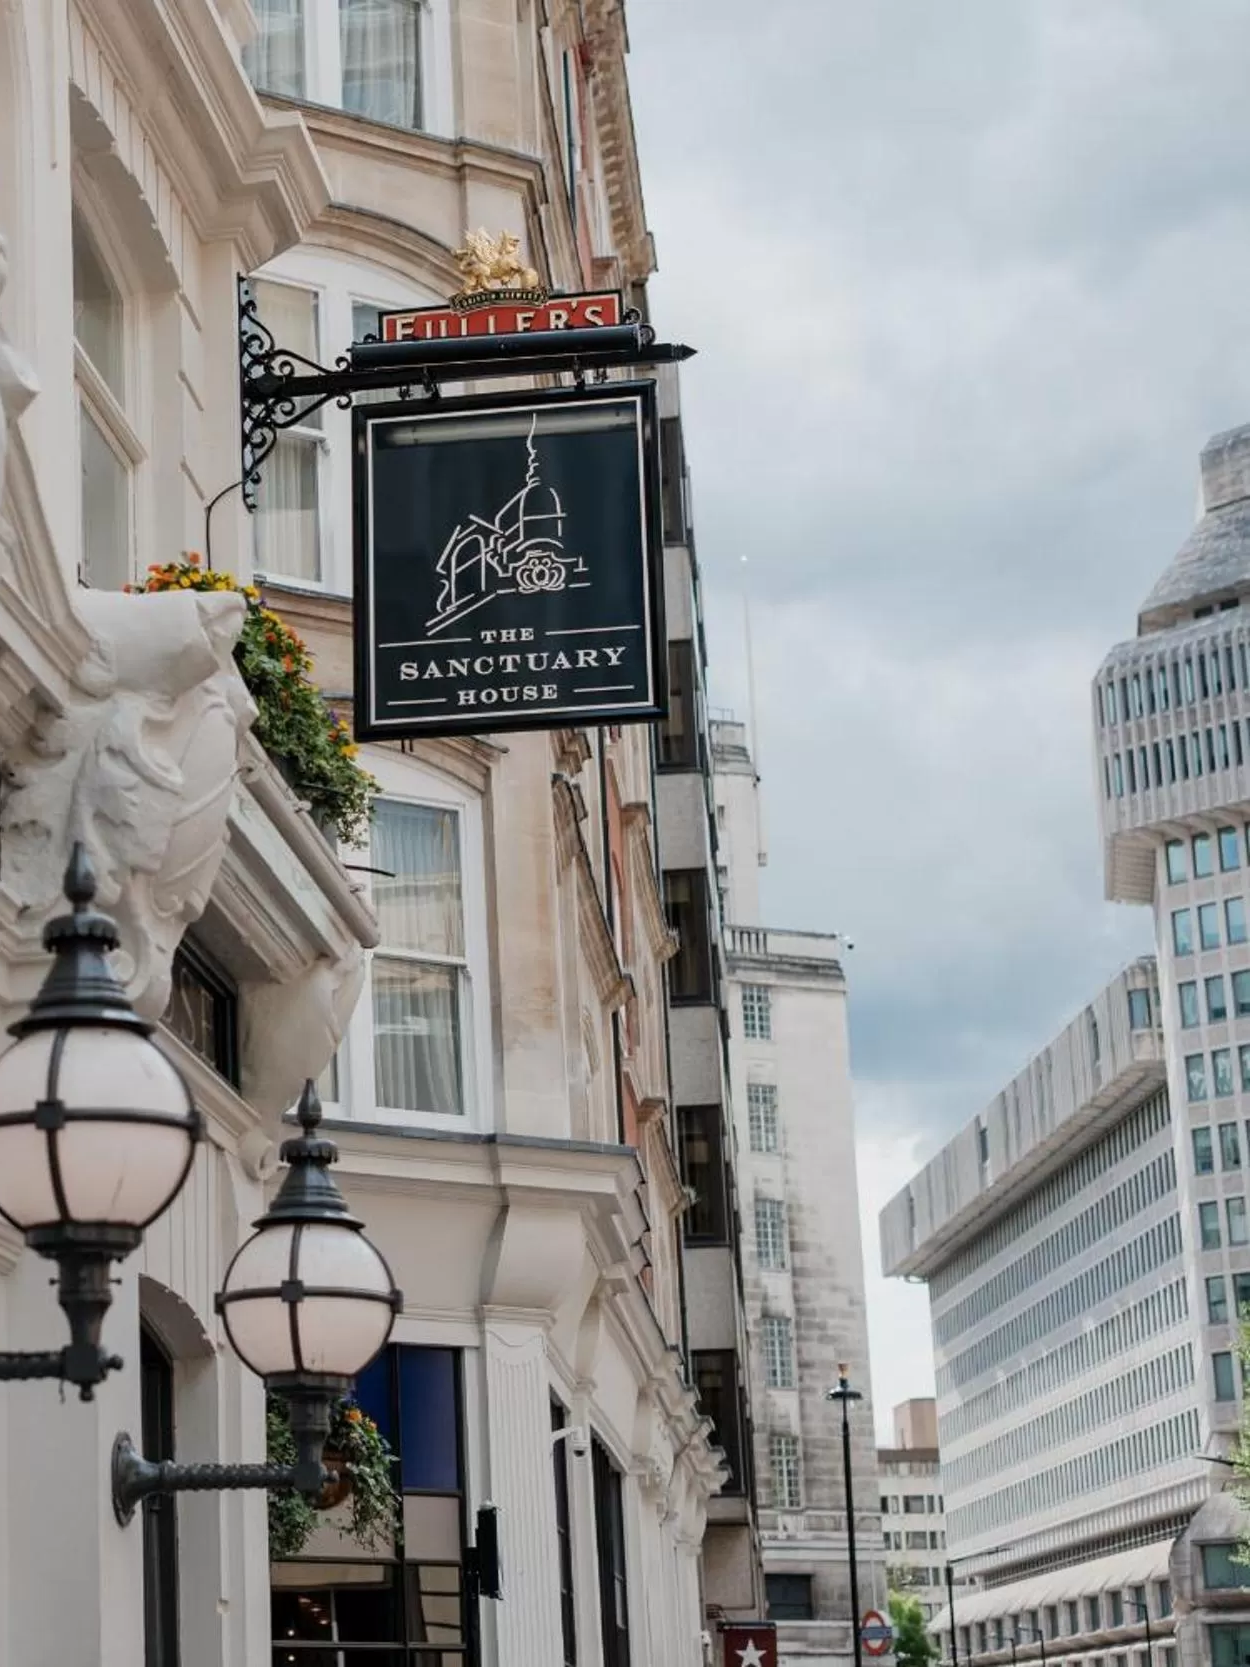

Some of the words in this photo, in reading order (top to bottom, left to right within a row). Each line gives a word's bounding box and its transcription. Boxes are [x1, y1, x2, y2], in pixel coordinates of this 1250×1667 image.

[481, 628, 534, 644] THE
[400, 646, 627, 681] SANCTUARY
[457, 684, 558, 706] HOUSE
